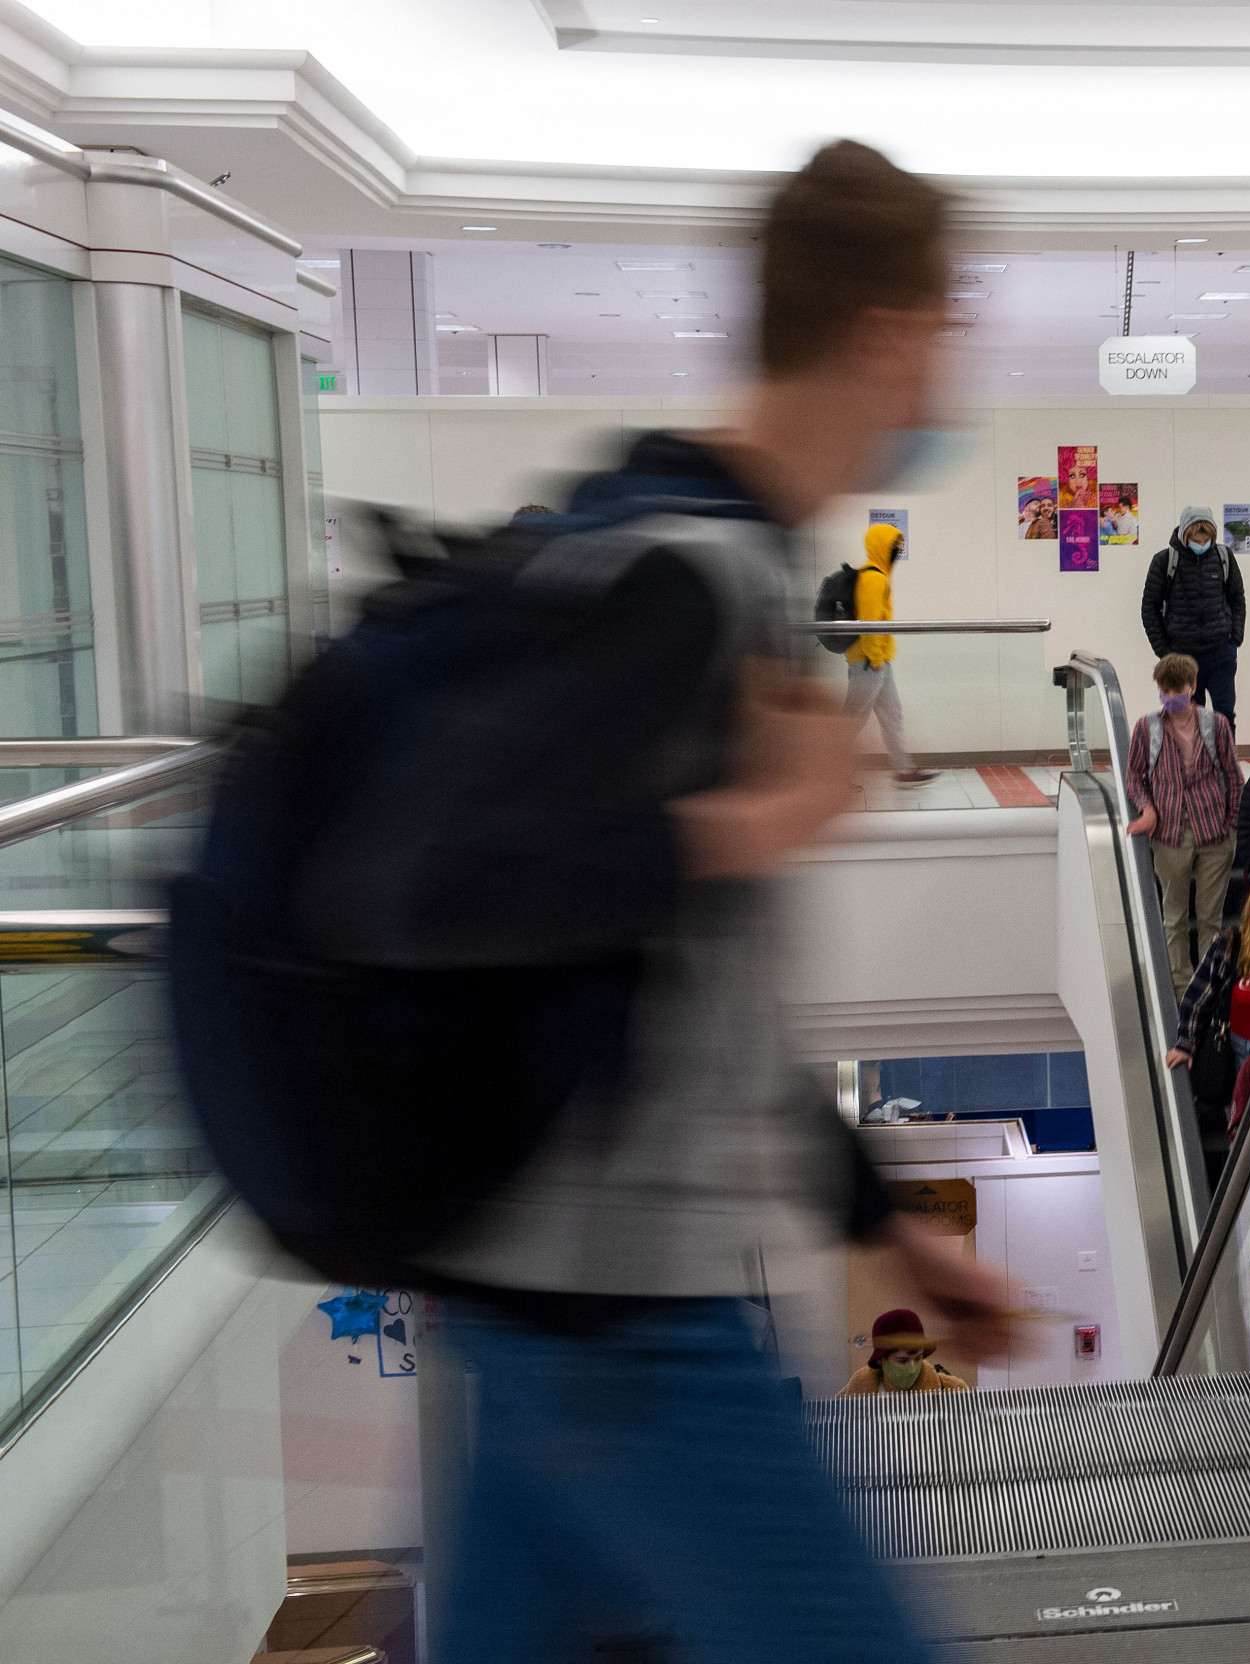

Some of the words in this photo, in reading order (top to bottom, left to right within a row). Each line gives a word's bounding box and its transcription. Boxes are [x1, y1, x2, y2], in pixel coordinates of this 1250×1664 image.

[1107, 352, 1185, 365] ESCALATOR
[1126, 367, 1168, 380] DOWN
[315, 375, 335, 391] XIT
[1042, 1601, 1173, 1620] Schindler
